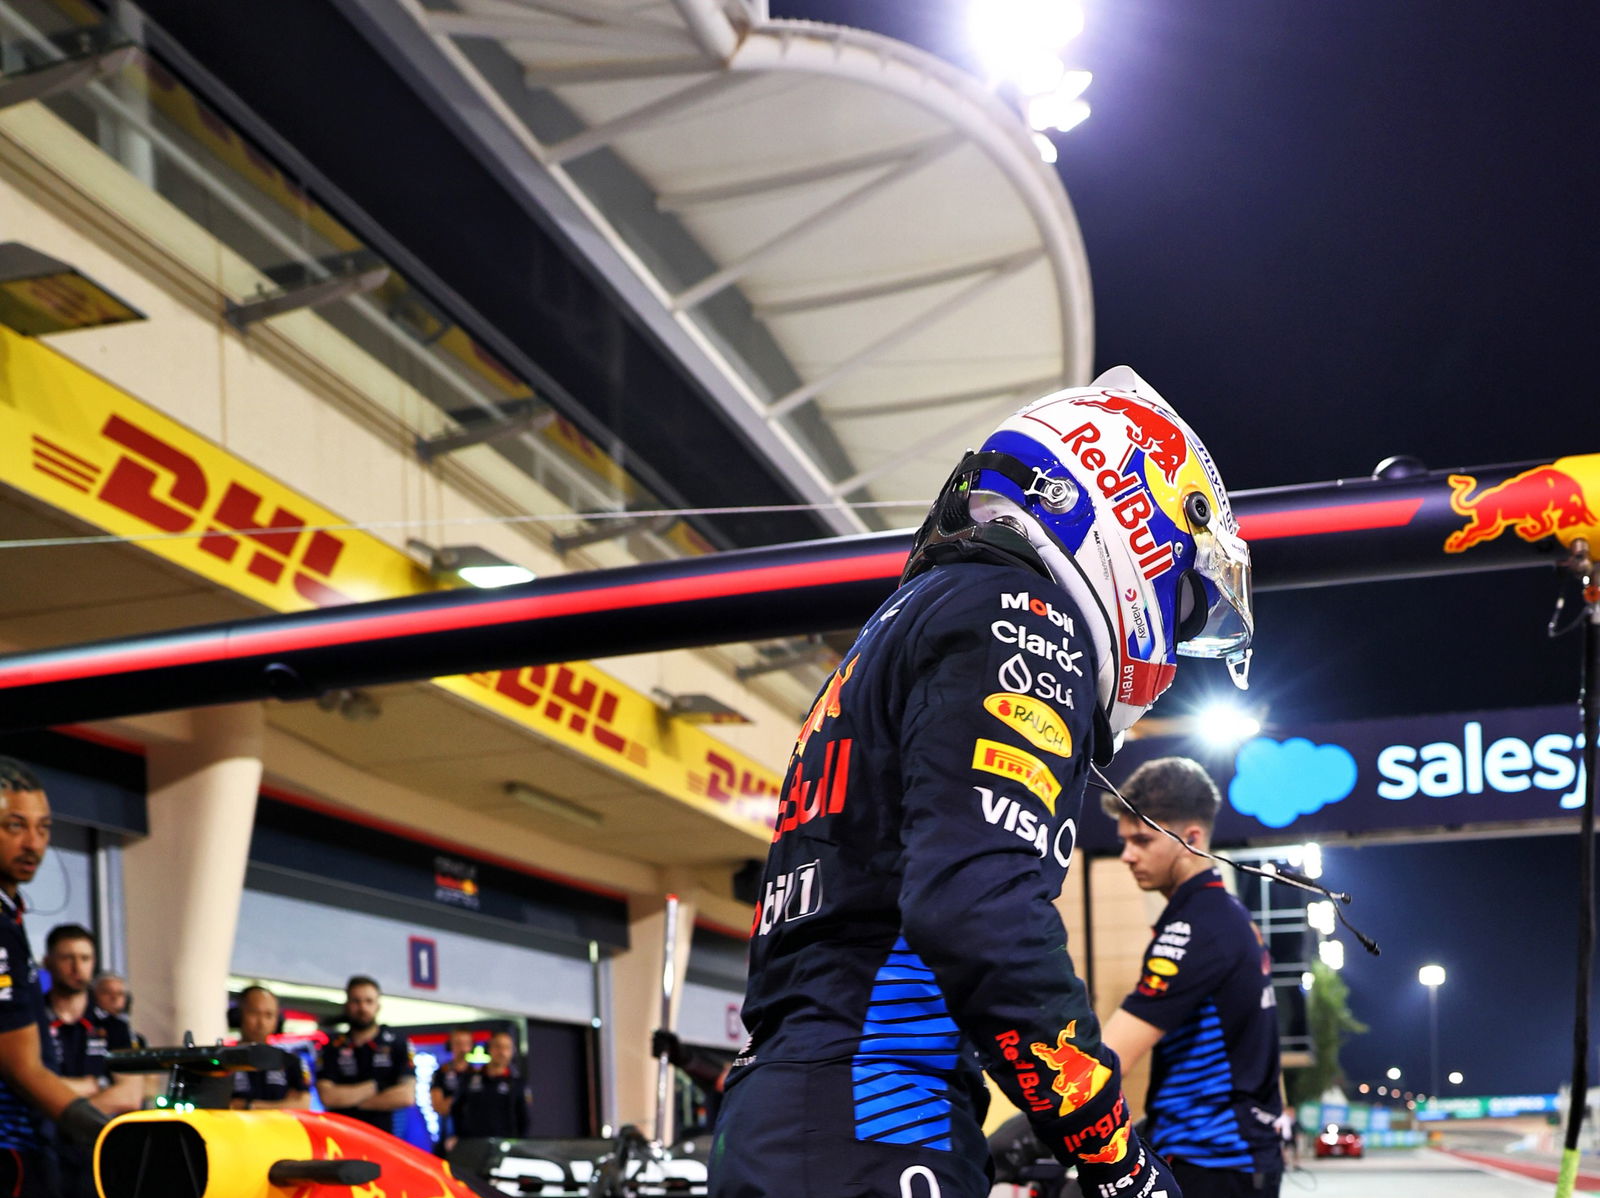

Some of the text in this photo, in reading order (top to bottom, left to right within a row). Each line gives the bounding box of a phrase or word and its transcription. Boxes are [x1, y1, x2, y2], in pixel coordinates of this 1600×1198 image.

[98, 413, 358, 607] DHL
[1000, 591, 1074, 637] Mobil
[1131, 602, 1147, 639] viaplay
[990, 620, 1076, 673] Claro
[1035, 671, 1075, 711] Sui
[1120, 664, 1134, 700] BYBIT
[495, 662, 626, 754] DHL
[1014, 704, 1065, 752] RAUCH
[965, 785, 1049, 860] VISA
[750, 871, 796, 938] obil
